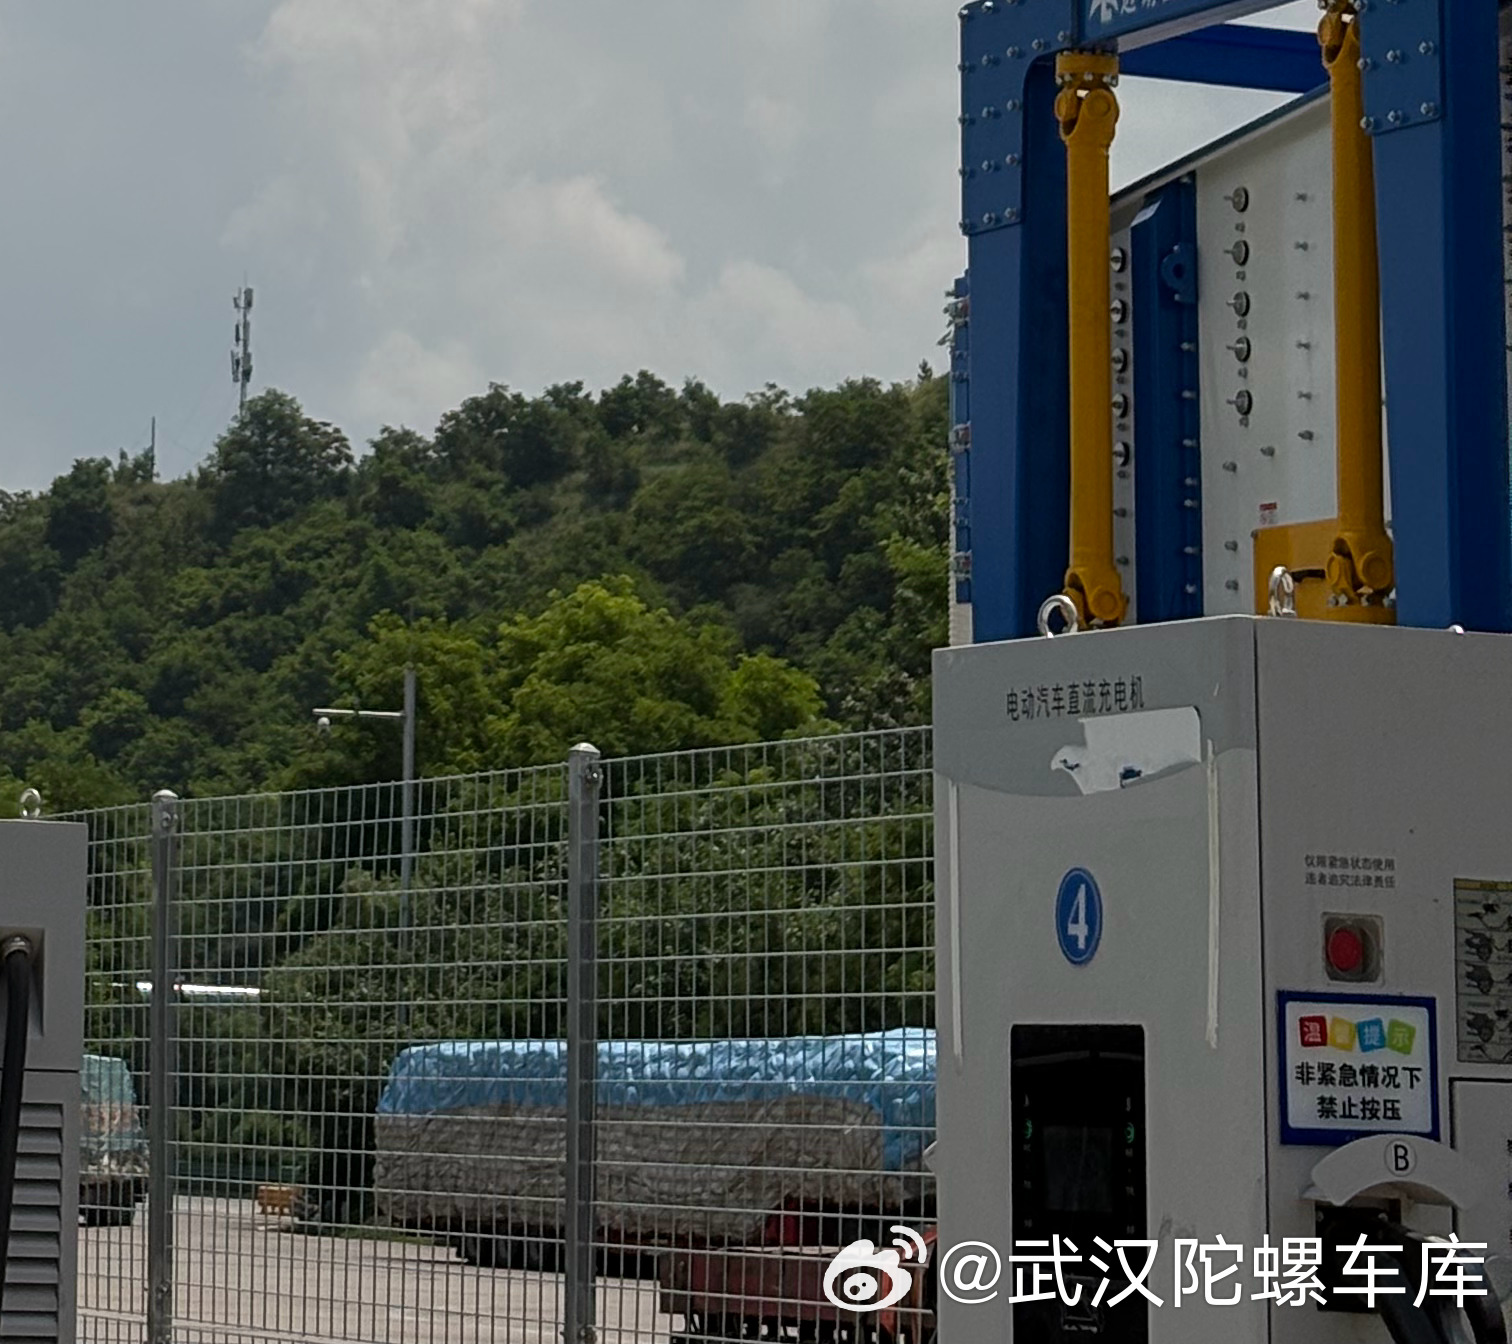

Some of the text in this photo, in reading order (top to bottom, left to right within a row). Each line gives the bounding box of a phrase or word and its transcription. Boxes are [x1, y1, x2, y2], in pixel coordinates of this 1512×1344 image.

[1006, 675, 1145, 721] 电动汽车直流充电机
[1067, 883, 1088, 950] 4
[1295, 1061, 1423, 1089] 非紧急情况下
[1316, 1095, 1402, 1121] 禁止按压
[1394, 1144, 1409, 1171] B
